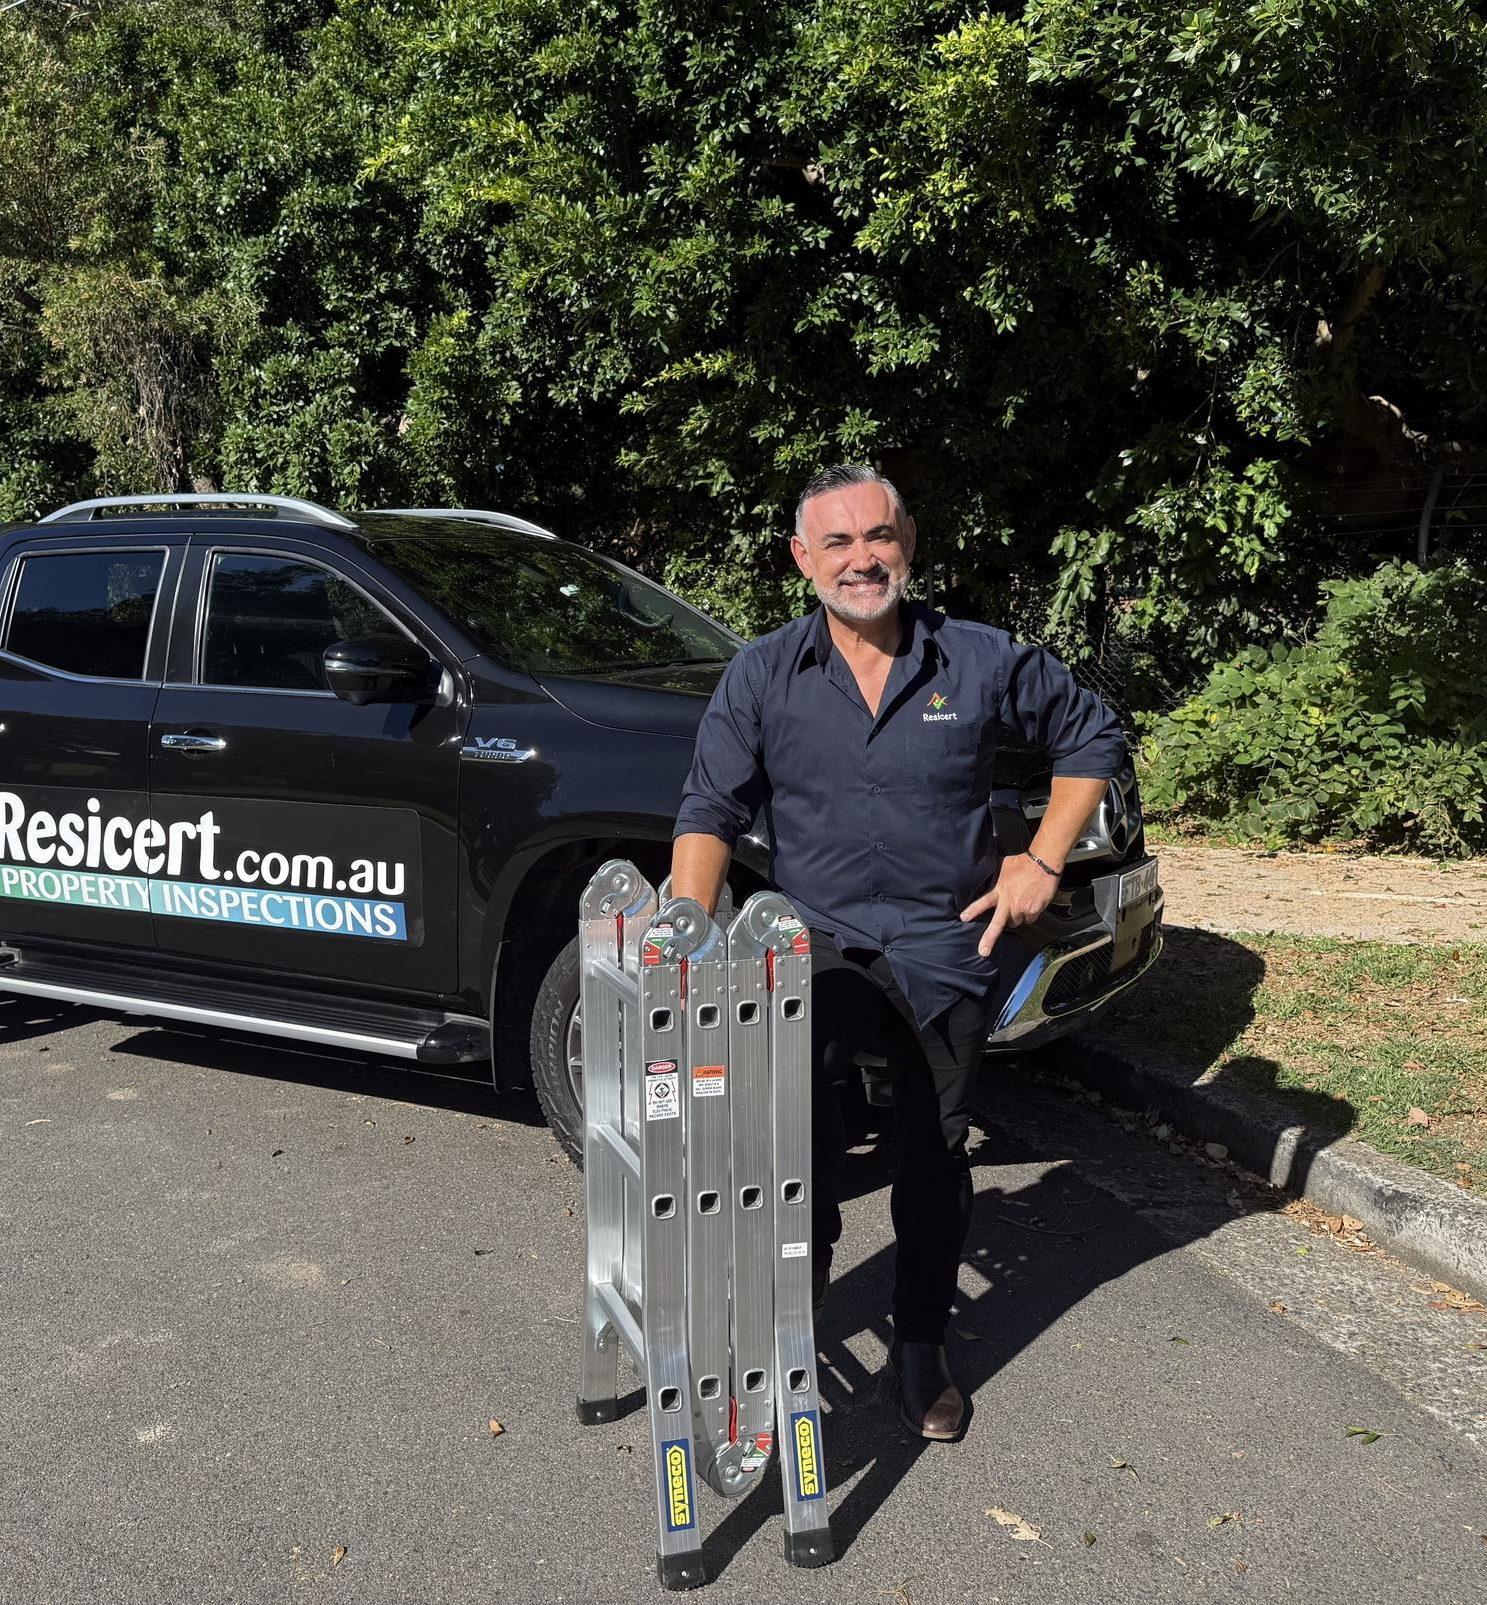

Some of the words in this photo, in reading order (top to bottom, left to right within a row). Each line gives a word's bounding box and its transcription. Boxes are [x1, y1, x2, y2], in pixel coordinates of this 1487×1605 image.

[475, 737, 516, 750] V6
[923, 712, 958, 722] Resicert
[473, 751, 512, 759] TURBO
[0, 791, 405, 896] Resicert.com.au
[1, 867, 153, 909] PROPERTY
[162, 884, 397, 936] INSPECTIONS
[671, 1451, 689, 1526] syneco
[799, 1423, 818, 1496] syneco
